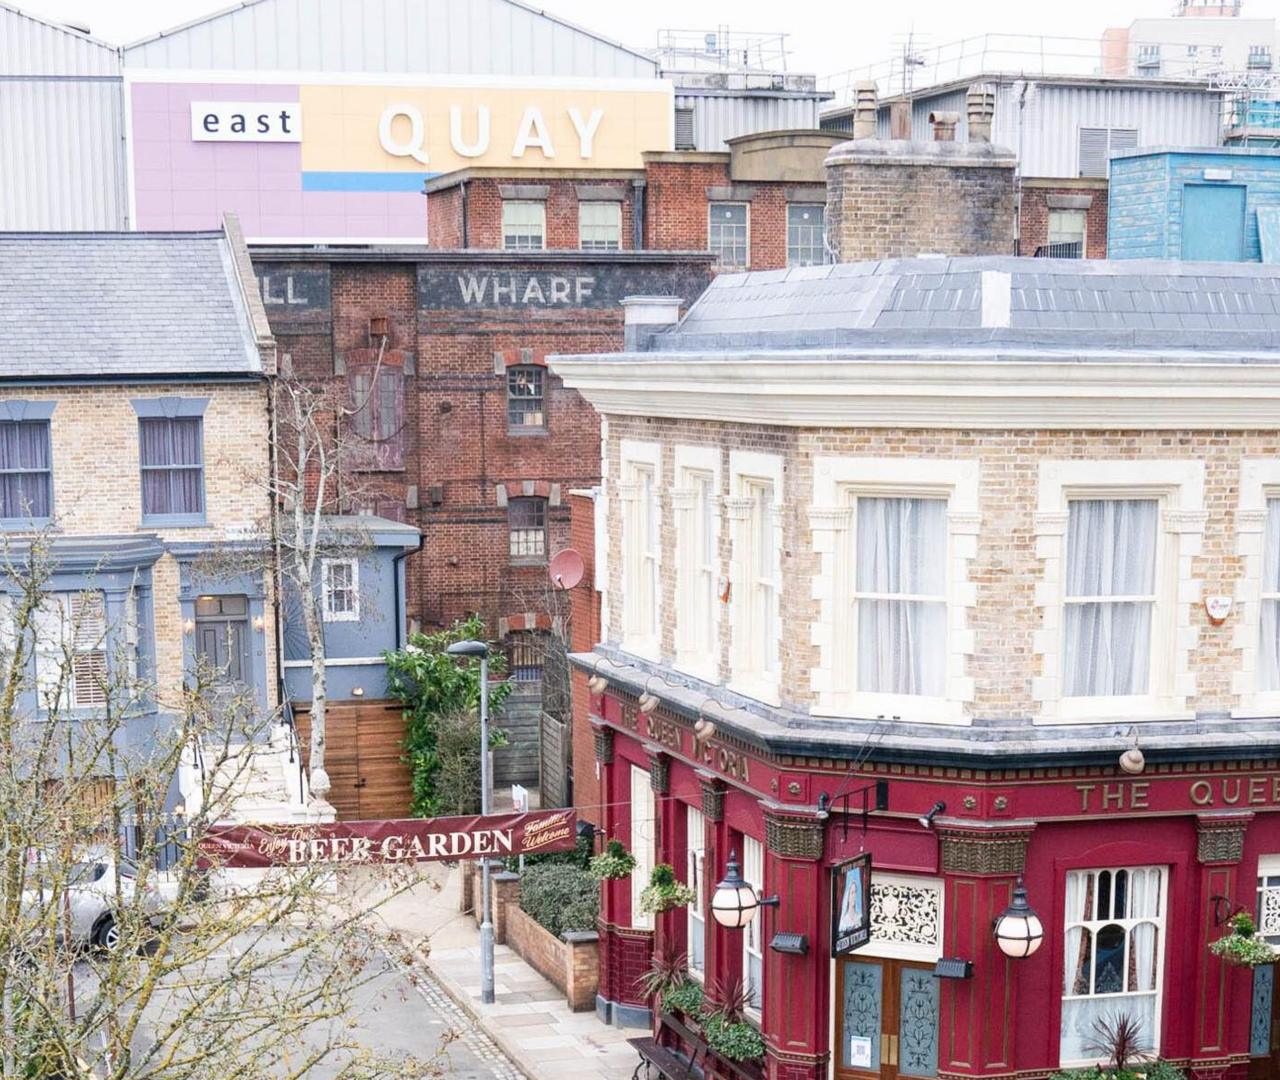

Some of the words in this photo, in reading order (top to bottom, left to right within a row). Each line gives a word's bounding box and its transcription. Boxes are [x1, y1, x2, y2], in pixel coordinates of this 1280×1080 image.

[202, 109, 292, 134] east
[377, 103, 605, 165] QUAY
[458, 275, 596, 304] WHARF
[1075, 781, 1151, 812] THE
[287, 836, 374, 863] BEER
[381, 828, 514, 860] GARDEN
[521, 826, 570, 848] Welcome
